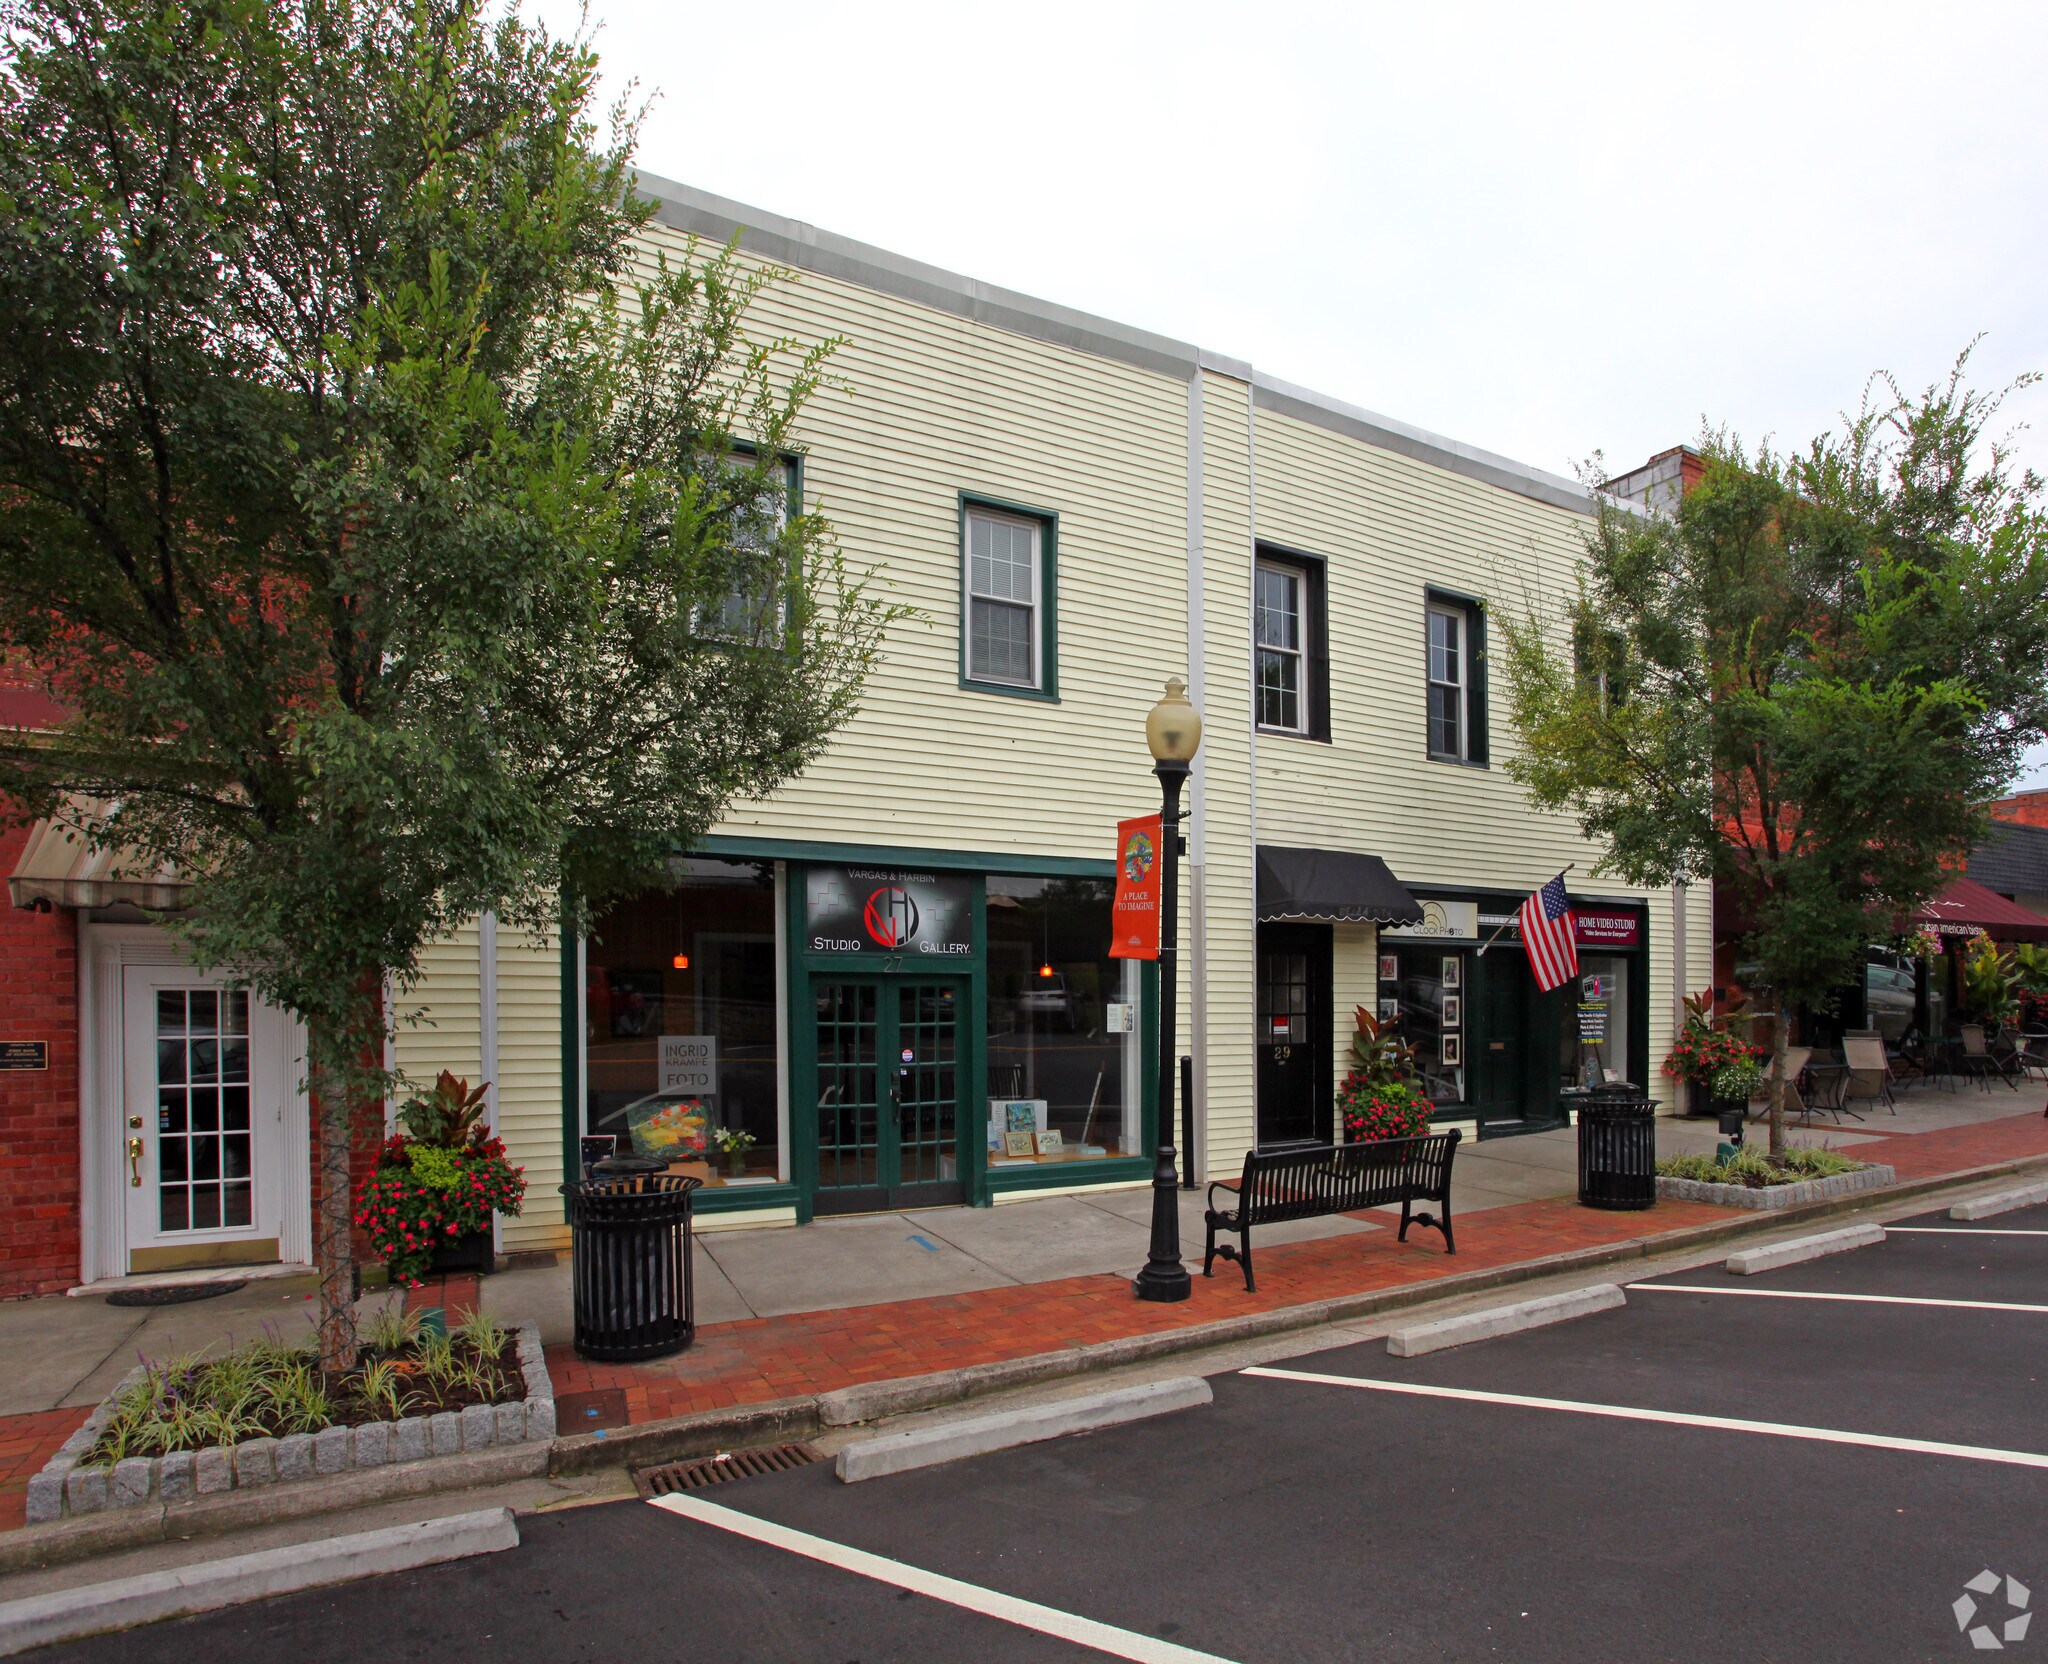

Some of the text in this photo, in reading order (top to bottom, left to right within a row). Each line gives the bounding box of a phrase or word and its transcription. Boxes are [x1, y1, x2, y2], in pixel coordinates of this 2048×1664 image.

[848, 868, 888, 880] VARGAS
[898, 872, 935, 883] HARBIN
[1123, 891, 1148, 900] A PLACE
[1118, 901, 1154, 911] TO IMAGINE
[1412, 925, 1438, 934] CLOCK
[1578, 916, 1635, 930] HOME VIDEO STUDIO
[814, 937, 861, 951] STUDIO
[883, 956, 903, 973] 27
[665, 1044, 708, 1057] INGRID
[1274, 1046, 1290, 1060] 29
[665, 1057, 708, 1066] KRAMPE
[667, 1073, 709, 1086] FOTO
